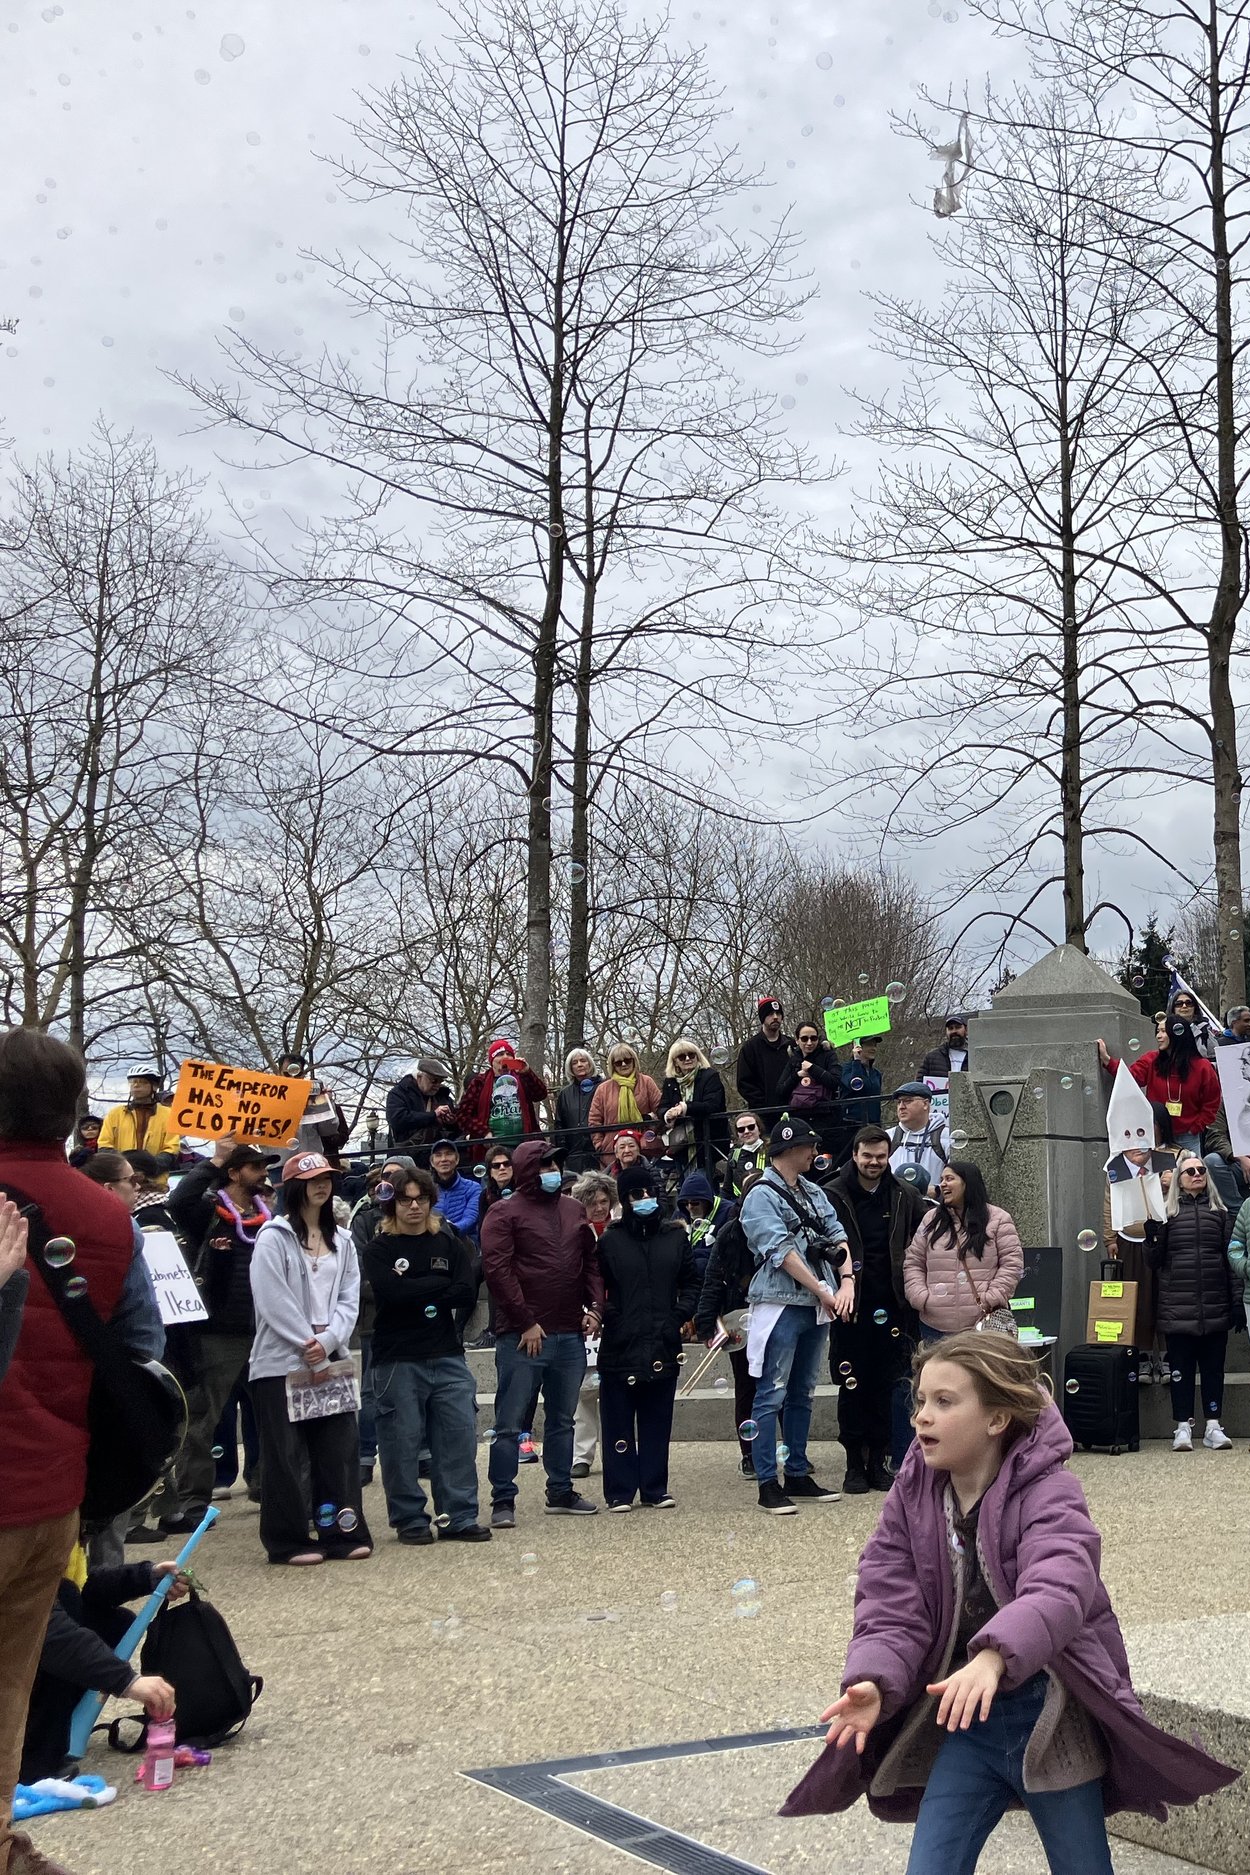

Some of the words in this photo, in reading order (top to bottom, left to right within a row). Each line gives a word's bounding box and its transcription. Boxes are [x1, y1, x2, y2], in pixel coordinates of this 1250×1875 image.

[845, 1017, 864, 1031] NOT
[188, 1063, 214, 1081] THE
[215, 1068, 288, 1100] EMPEROR
[188, 1087, 223, 1109] HAS
[238, 1100, 261, 1115] NO
[177, 1108, 292, 1140] CLOTHES!
[164, 1290, 206, 1316] Ikea
